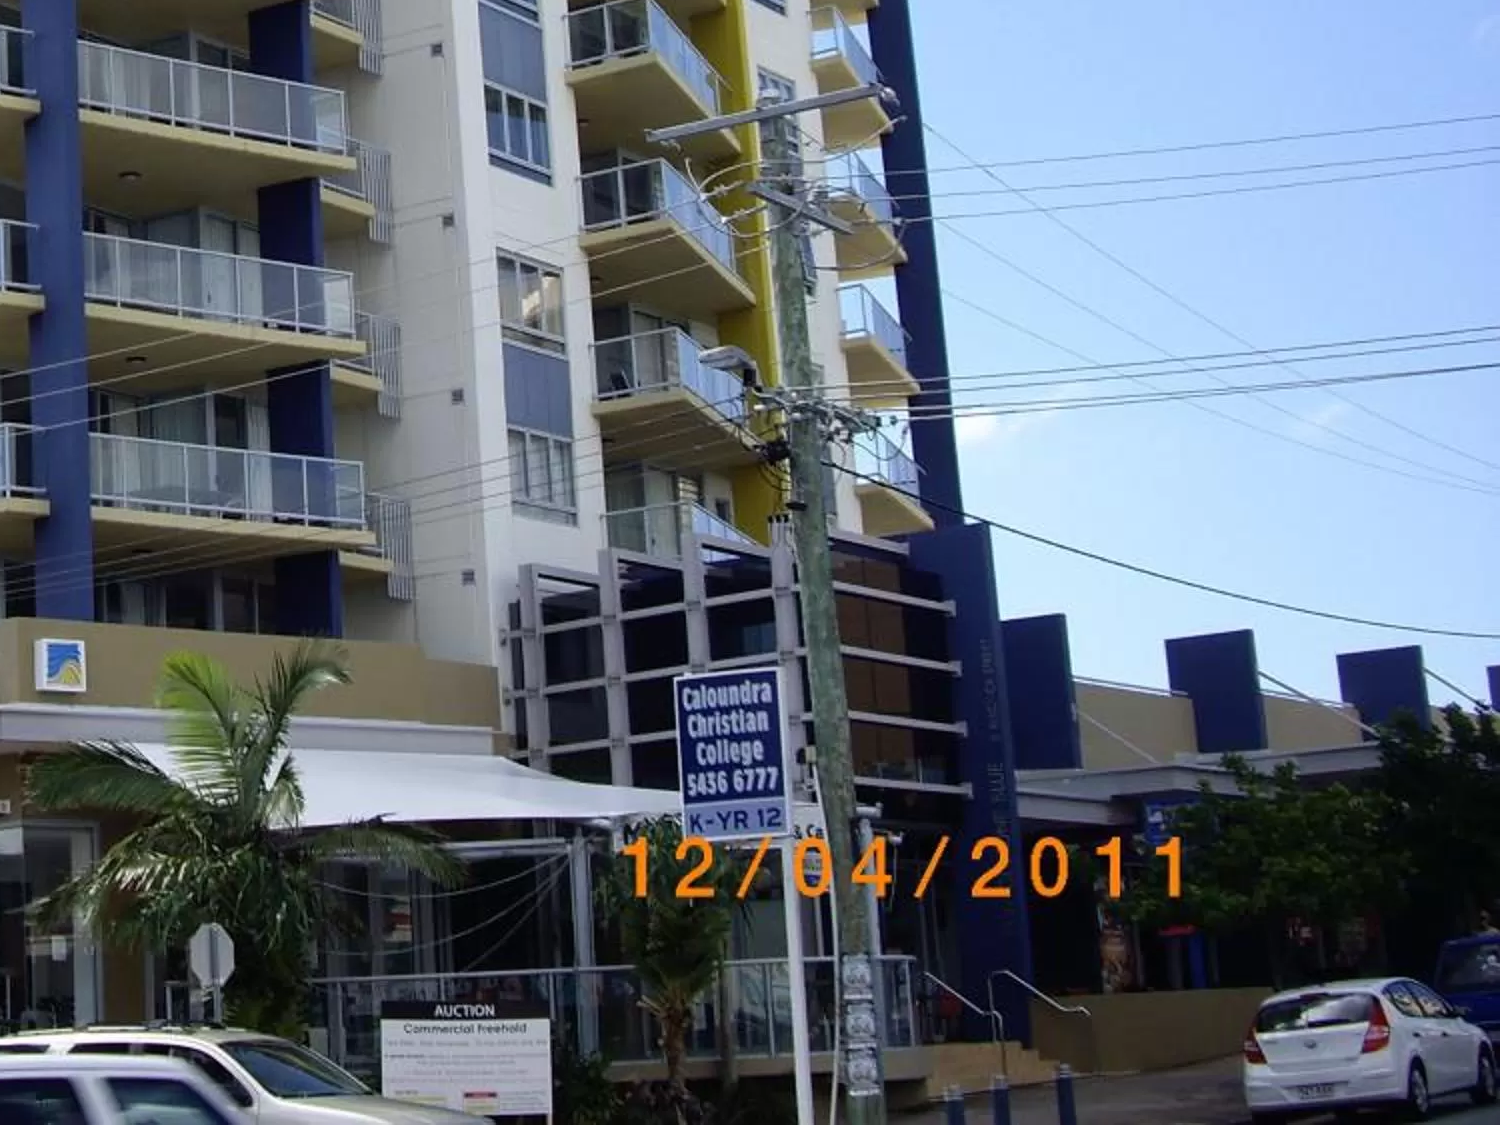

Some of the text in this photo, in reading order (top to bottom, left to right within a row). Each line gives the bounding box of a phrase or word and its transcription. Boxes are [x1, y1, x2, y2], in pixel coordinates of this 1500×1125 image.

[682, 679, 773, 711] Caloundra
[687, 709, 770, 738] Christian
[696, 738, 765, 766] College
[687, 766, 779, 797] 5436 6777
[689, 810, 749, 835] K-YR
[757, 806, 782, 830] 12
[434, 1004, 496, 1018] AUCTION
[403, 1022, 474, 1035] Commercial
